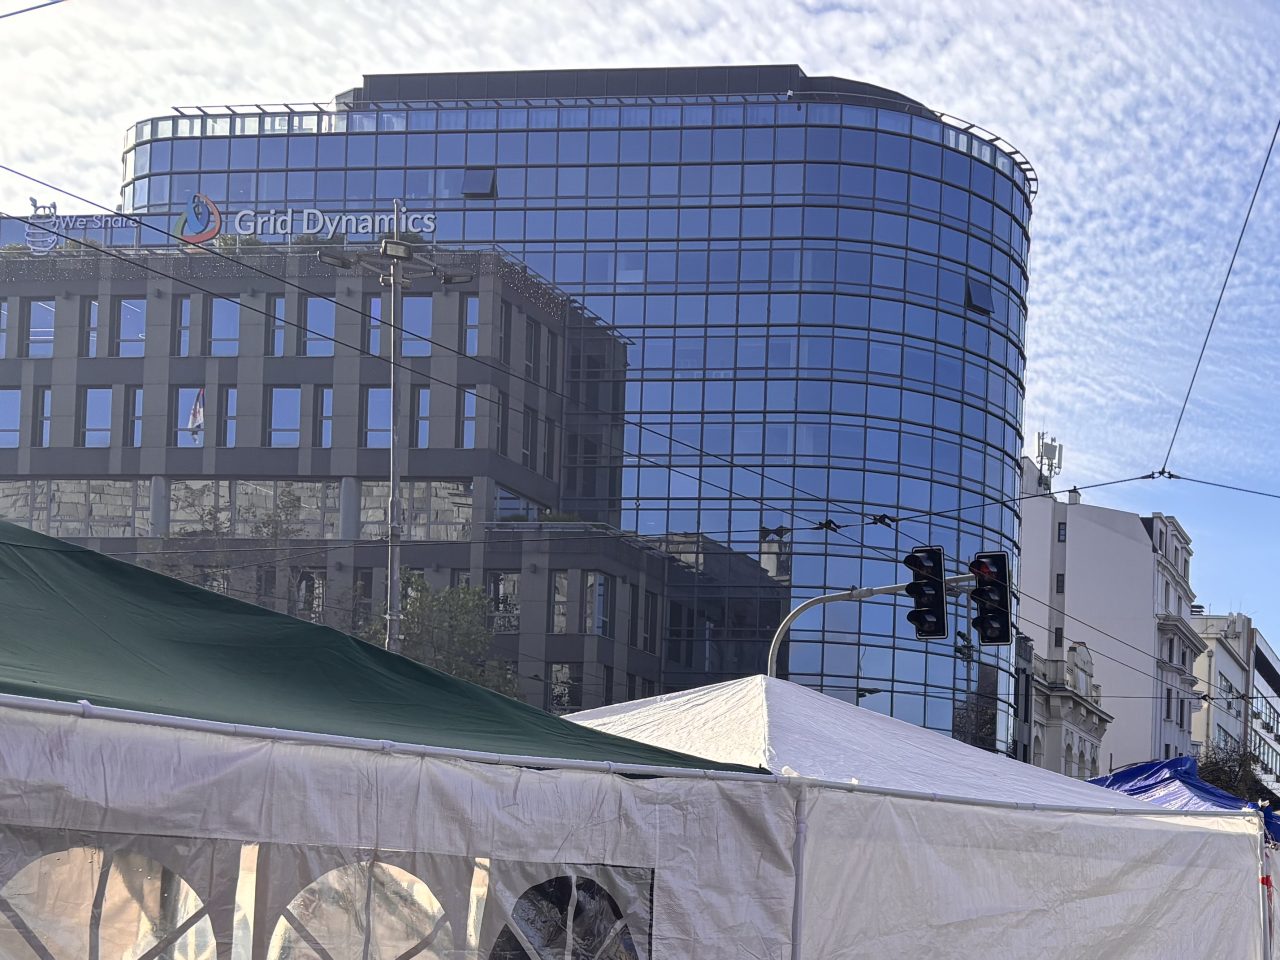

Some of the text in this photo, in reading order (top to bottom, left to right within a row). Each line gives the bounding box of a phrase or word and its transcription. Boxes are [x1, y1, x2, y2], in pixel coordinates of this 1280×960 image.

[61, 215, 141, 229] We Share
[234, 207, 437, 240] Grid Dynamics
